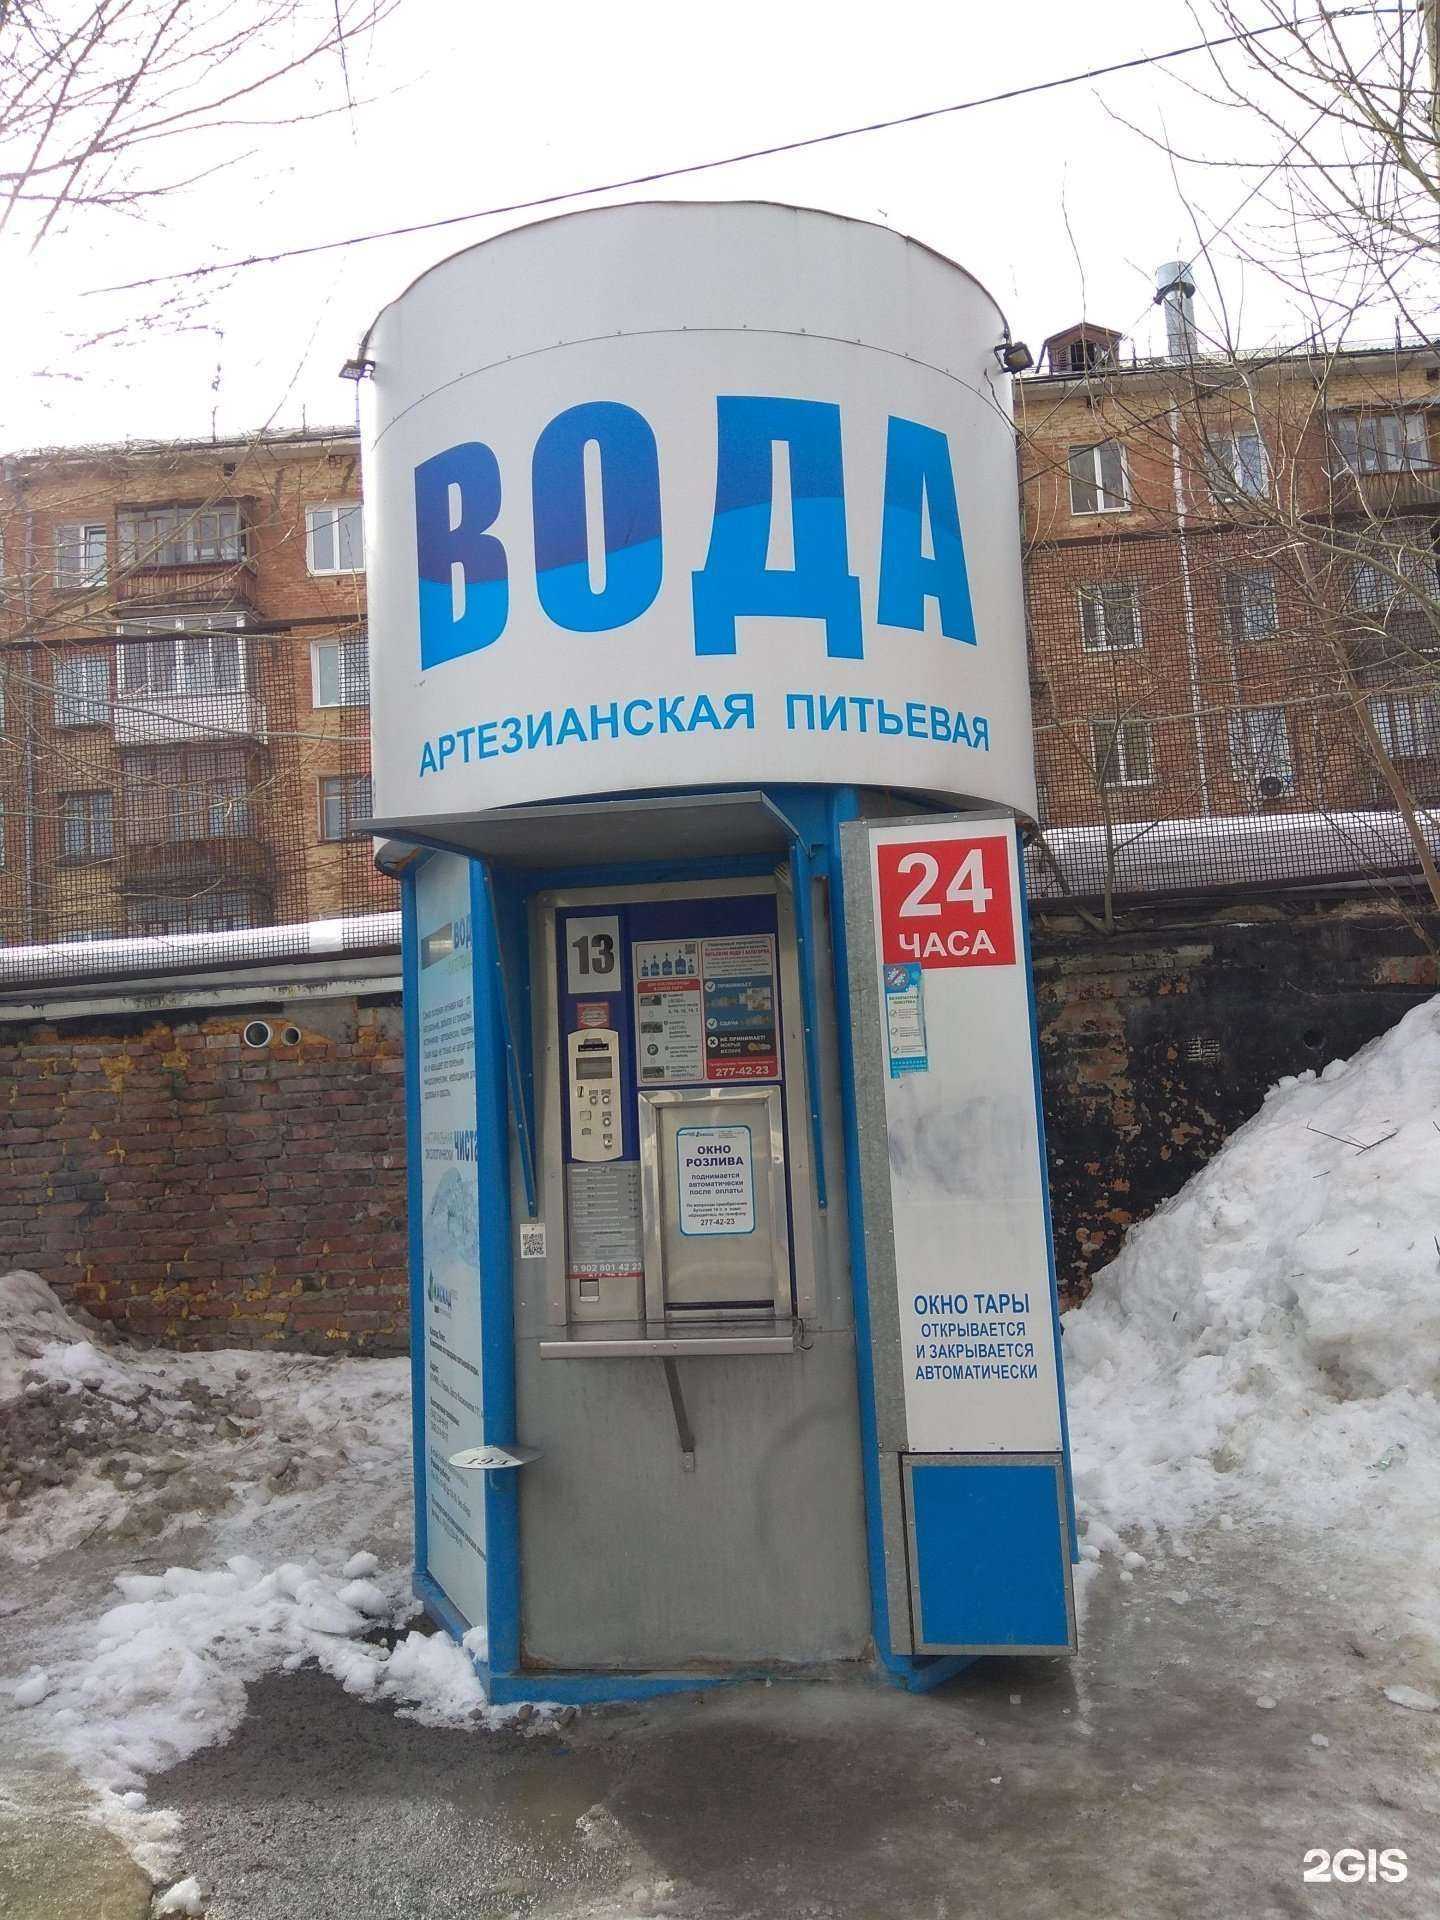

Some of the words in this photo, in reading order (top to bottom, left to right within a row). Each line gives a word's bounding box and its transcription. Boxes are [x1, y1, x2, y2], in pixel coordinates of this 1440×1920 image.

[414, 395, 977, 672] ВОДА
[419, 693, 755, 777] АРТЕЗИАНСКАЯ
[786, 693, 990, 752] ПИТЬЕВАЯ
[897, 848, 993, 917] 24
[899, 929, 996, 958] ЧАСА
[572, 933, 615, 975] 13
[715, 1066, 769, 1077] 277-42-23
[697, 1145, 731, 1155] ОКНО
[686, 1156, 744, 1167] РОЗЛИВА
[691, 1173, 740, 1181] поднимается
[700, 1218, 736, 1226] 277-42-23
[580, 1264, 597, 1272] 902
[914, 1294, 968, 1315] ОКНО
[973, 1293, 1030, 1314] ТАРЫ
[921, 1321, 1026, 1338] ОТКРЫВАЕТСЯ
[916, 1344, 926, 1358] И
[929, 1342, 1034, 1358] ЗАКРЫВАЕТСЯ
[915, 1364, 1038, 1380] АВТОМАТИЧЕСКИ
